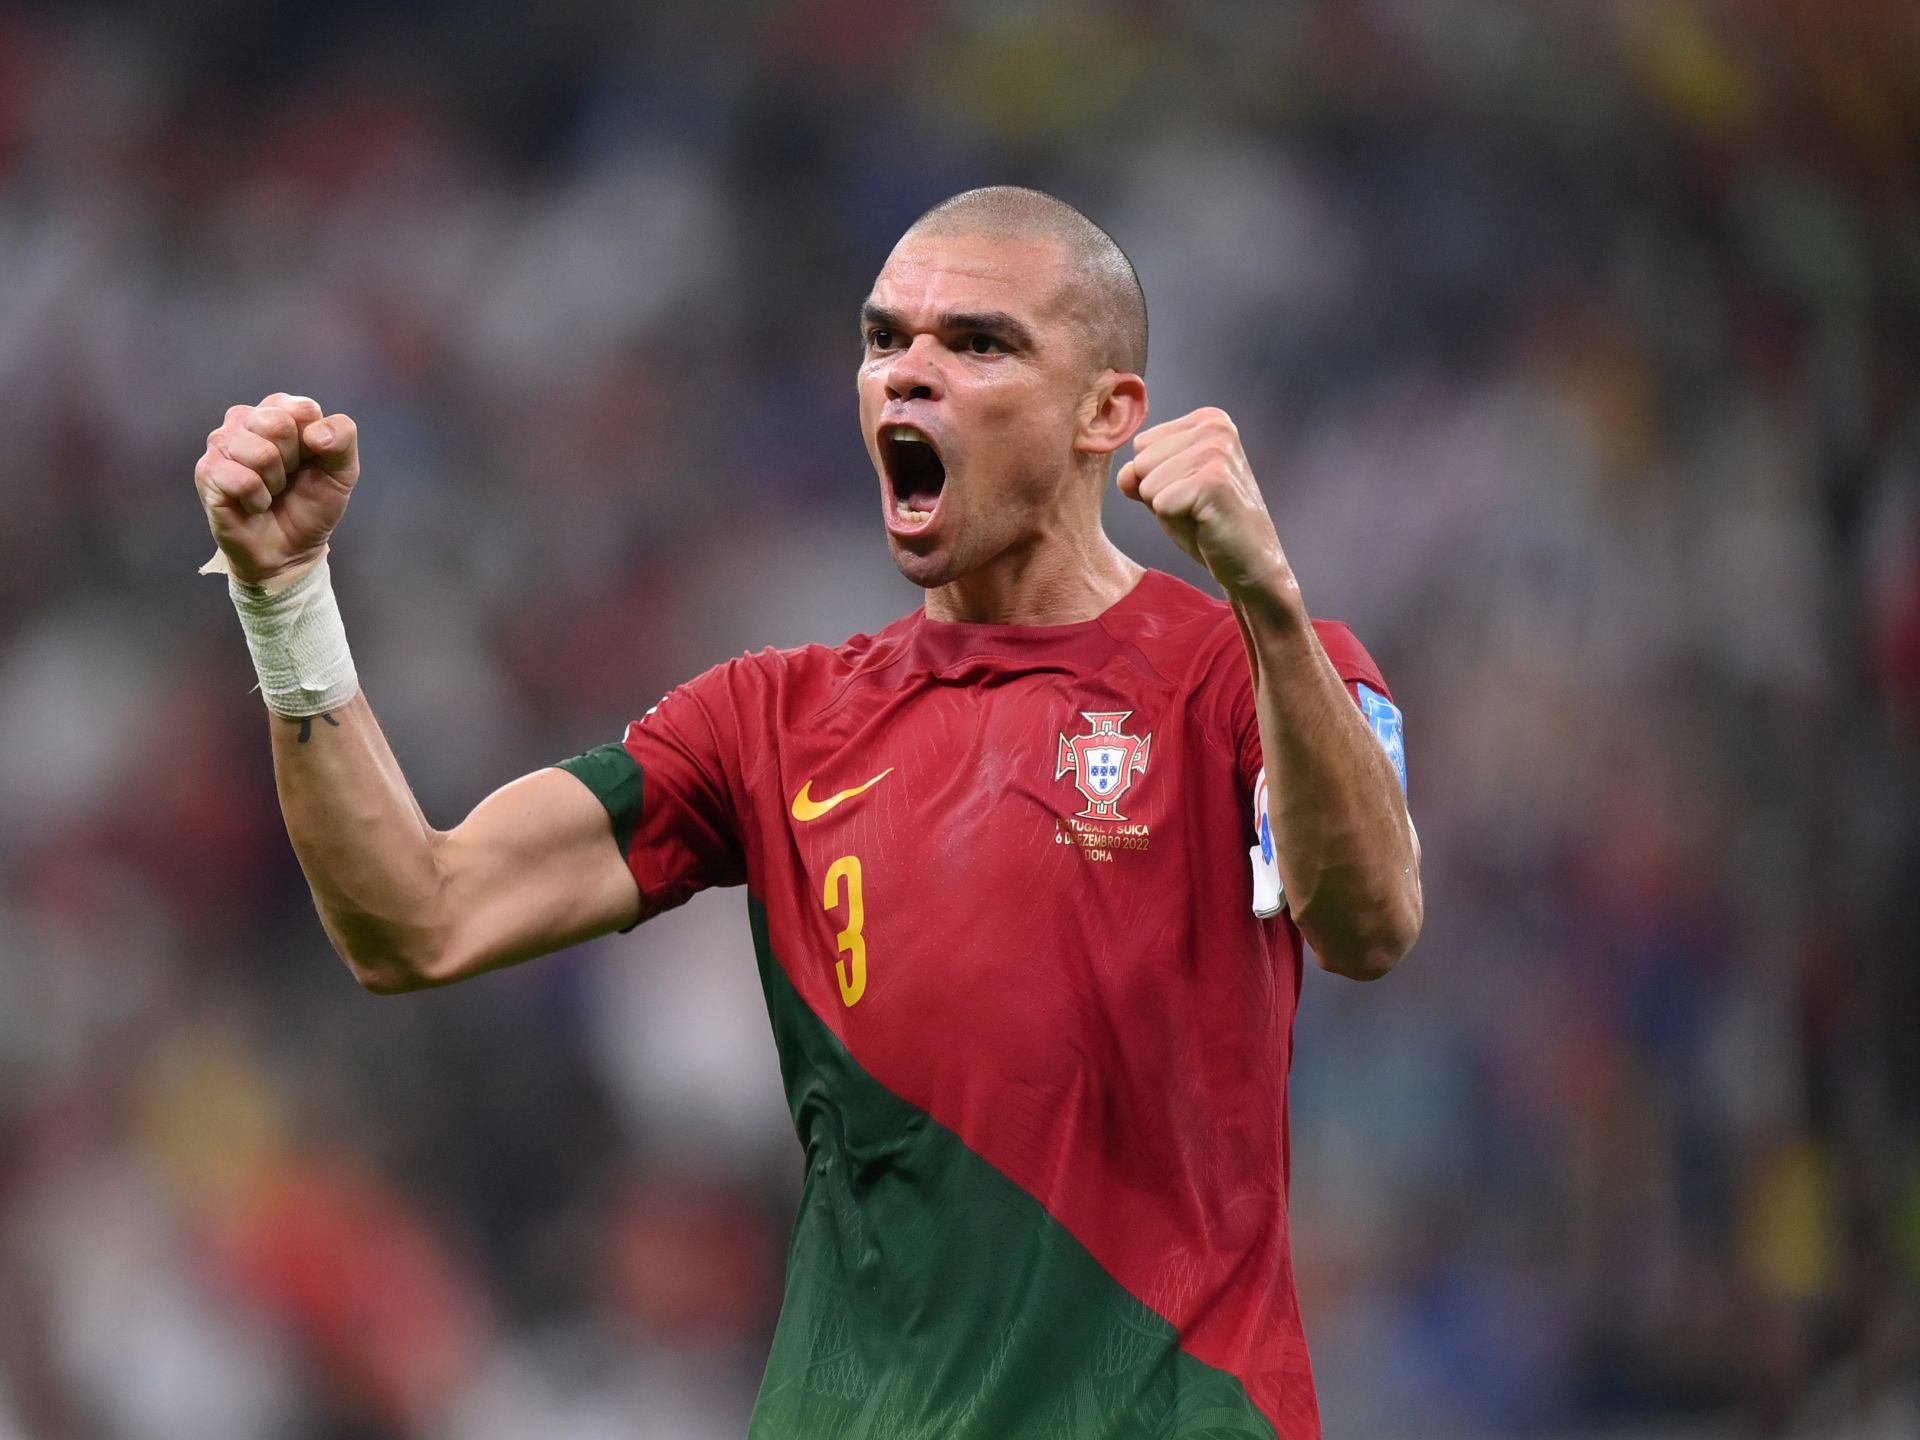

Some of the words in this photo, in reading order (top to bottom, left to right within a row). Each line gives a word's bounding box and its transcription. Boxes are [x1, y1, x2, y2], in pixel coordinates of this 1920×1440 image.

[1055, 832, 1062, 844] 6
[1122, 837, 1149, 850] 2022
[1085, 849, 1113, 862] DOHA
[823, 855, 867, 1007] 3
